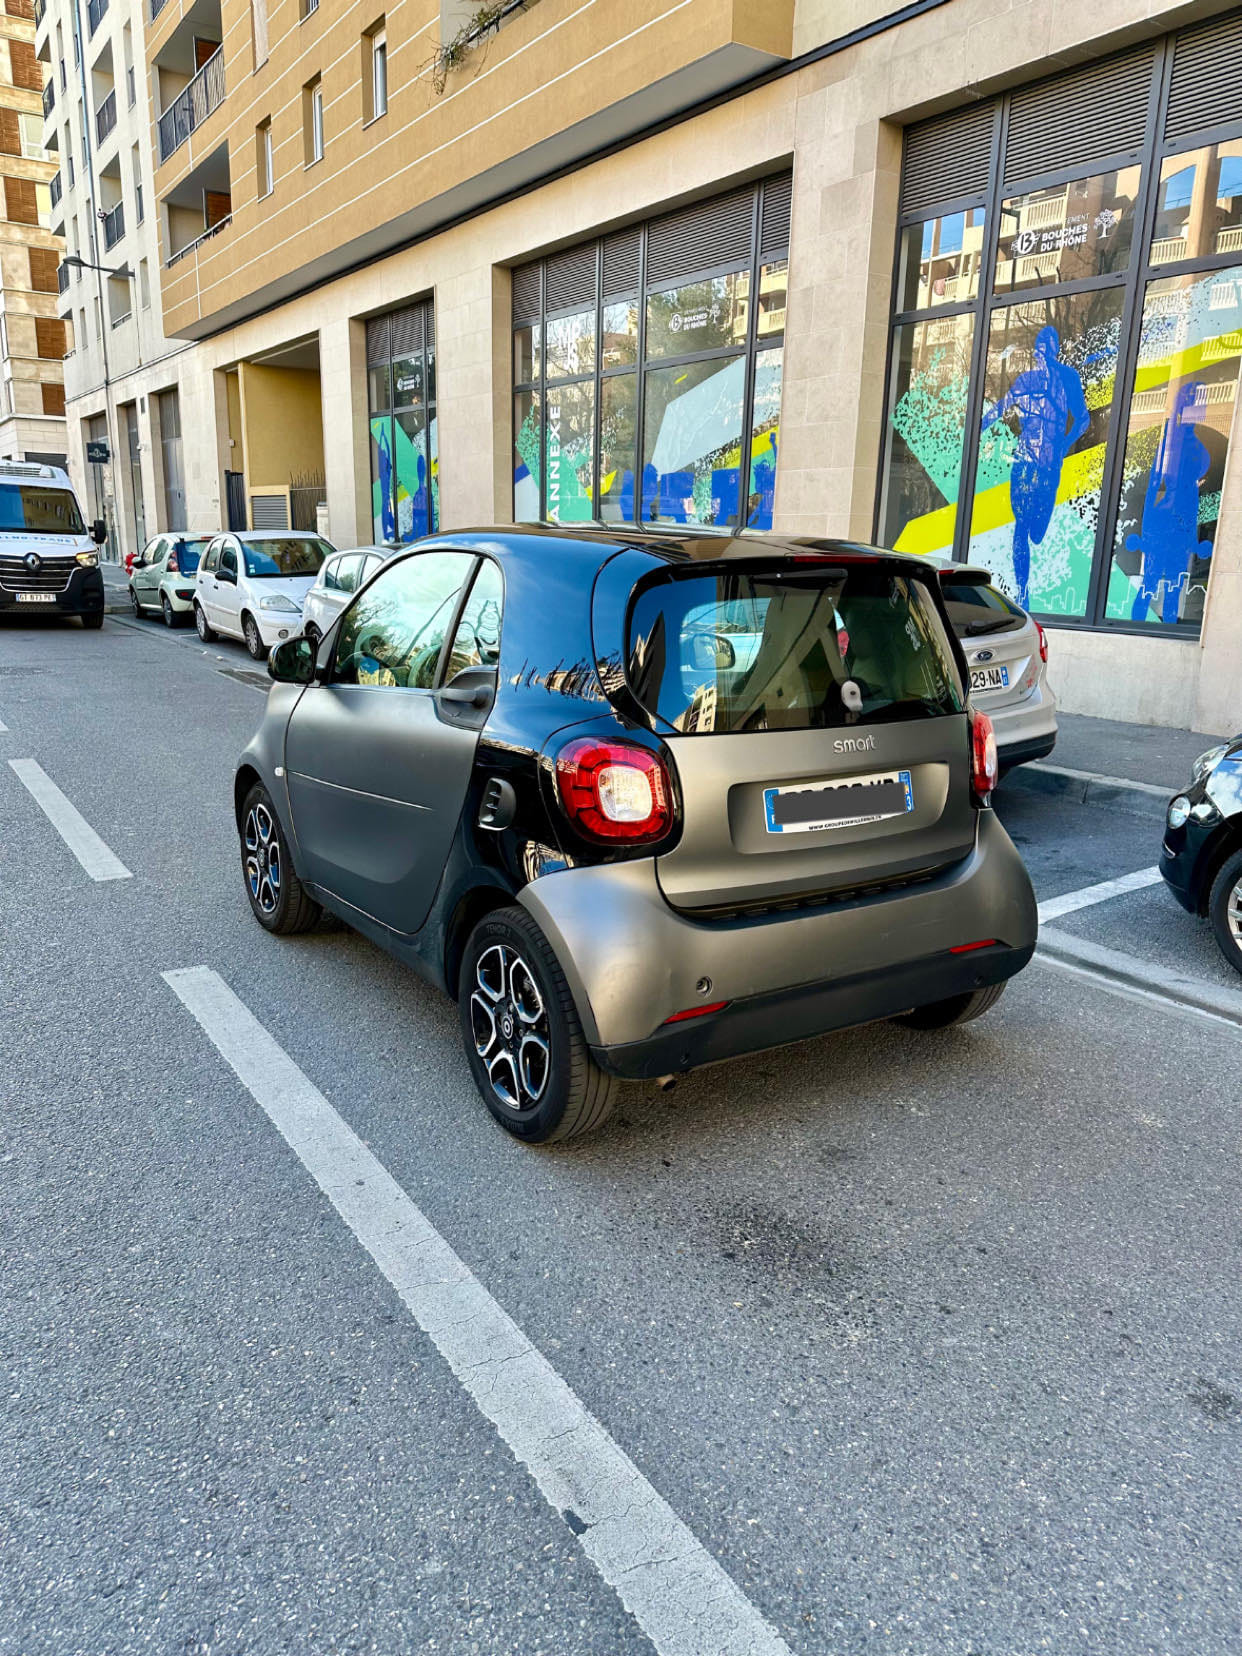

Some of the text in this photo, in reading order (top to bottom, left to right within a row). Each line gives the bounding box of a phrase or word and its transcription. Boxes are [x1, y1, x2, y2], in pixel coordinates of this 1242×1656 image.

[1041, 223, 1088, 241] BOUCHES
[1040, 242, 1053, 252] DU
[549, 406, 561, 521] ANNEXE
[833, 734, 877, 753] smart
